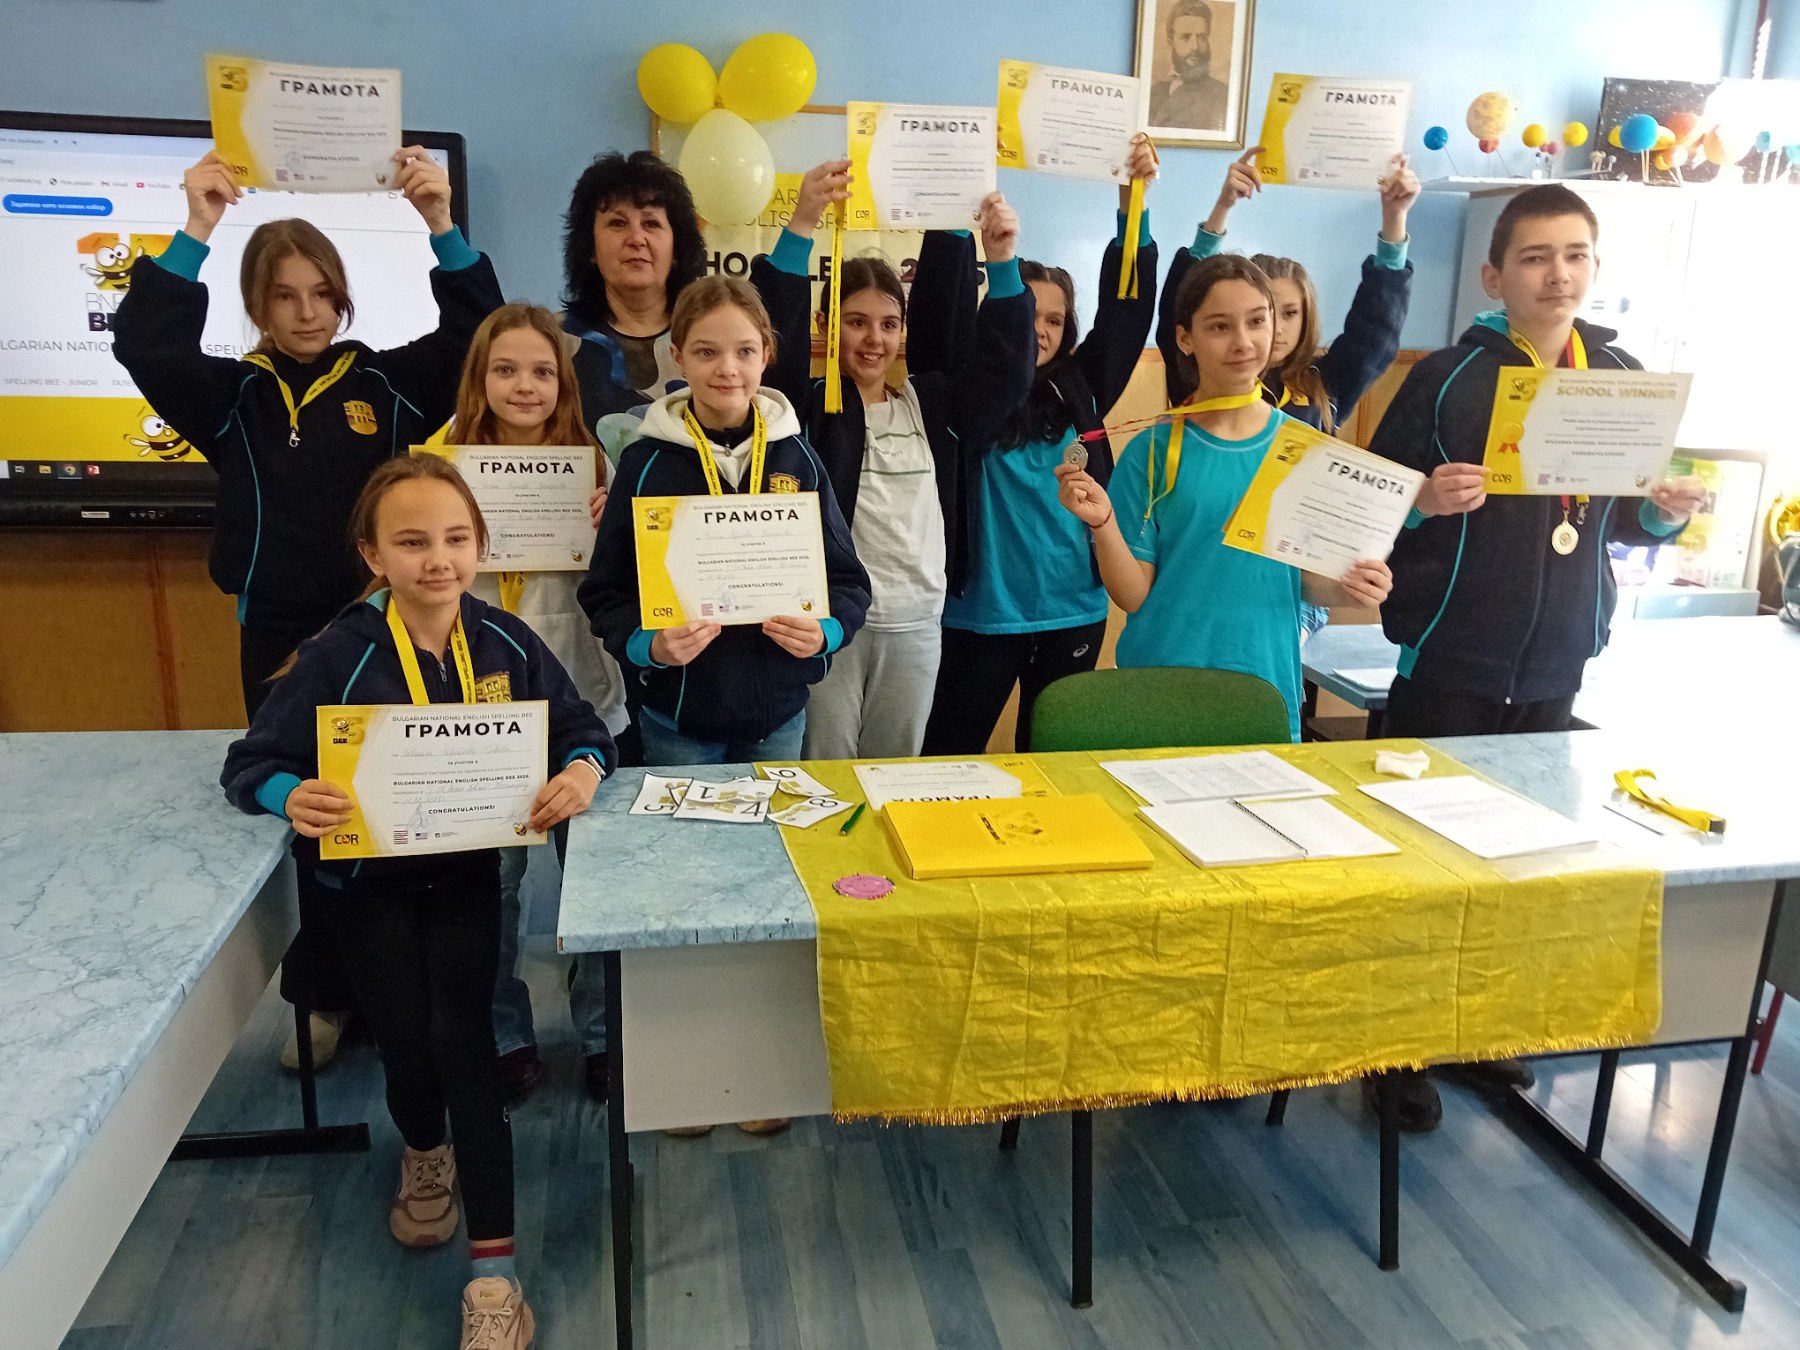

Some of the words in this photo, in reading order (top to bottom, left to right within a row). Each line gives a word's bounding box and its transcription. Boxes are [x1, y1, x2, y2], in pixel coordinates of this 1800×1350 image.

[280, 80, 380, 97] ГРАМОТА
[1052, 79, 1124, 99] ГРАМОТА
[1325, 92, 1397, 106] ГРАМОТА
[900, 120, 980, 134] ГРАМОТА
[67, 341, 112, 352] NATIO
[1557, 386, 1614, 397] SCHOOL
[1619, 388, 1677, 399] WINNER
[480, 462, 574, 474] ГРАМОТА
[1328, 461, 1405, 497] ГРАМОТА
[704, 509, 799, 523] ГРАМОТА
[405, 721, 522, 738] ГРАМОТА
[700, 786, 715, 799] 1
[428, 805, 495, 814] CONGRATULATIONS!
[644, 804, 675, 813] 5
[740, 802, 763, 816] 4
[809, 798, 838, 808] 8
